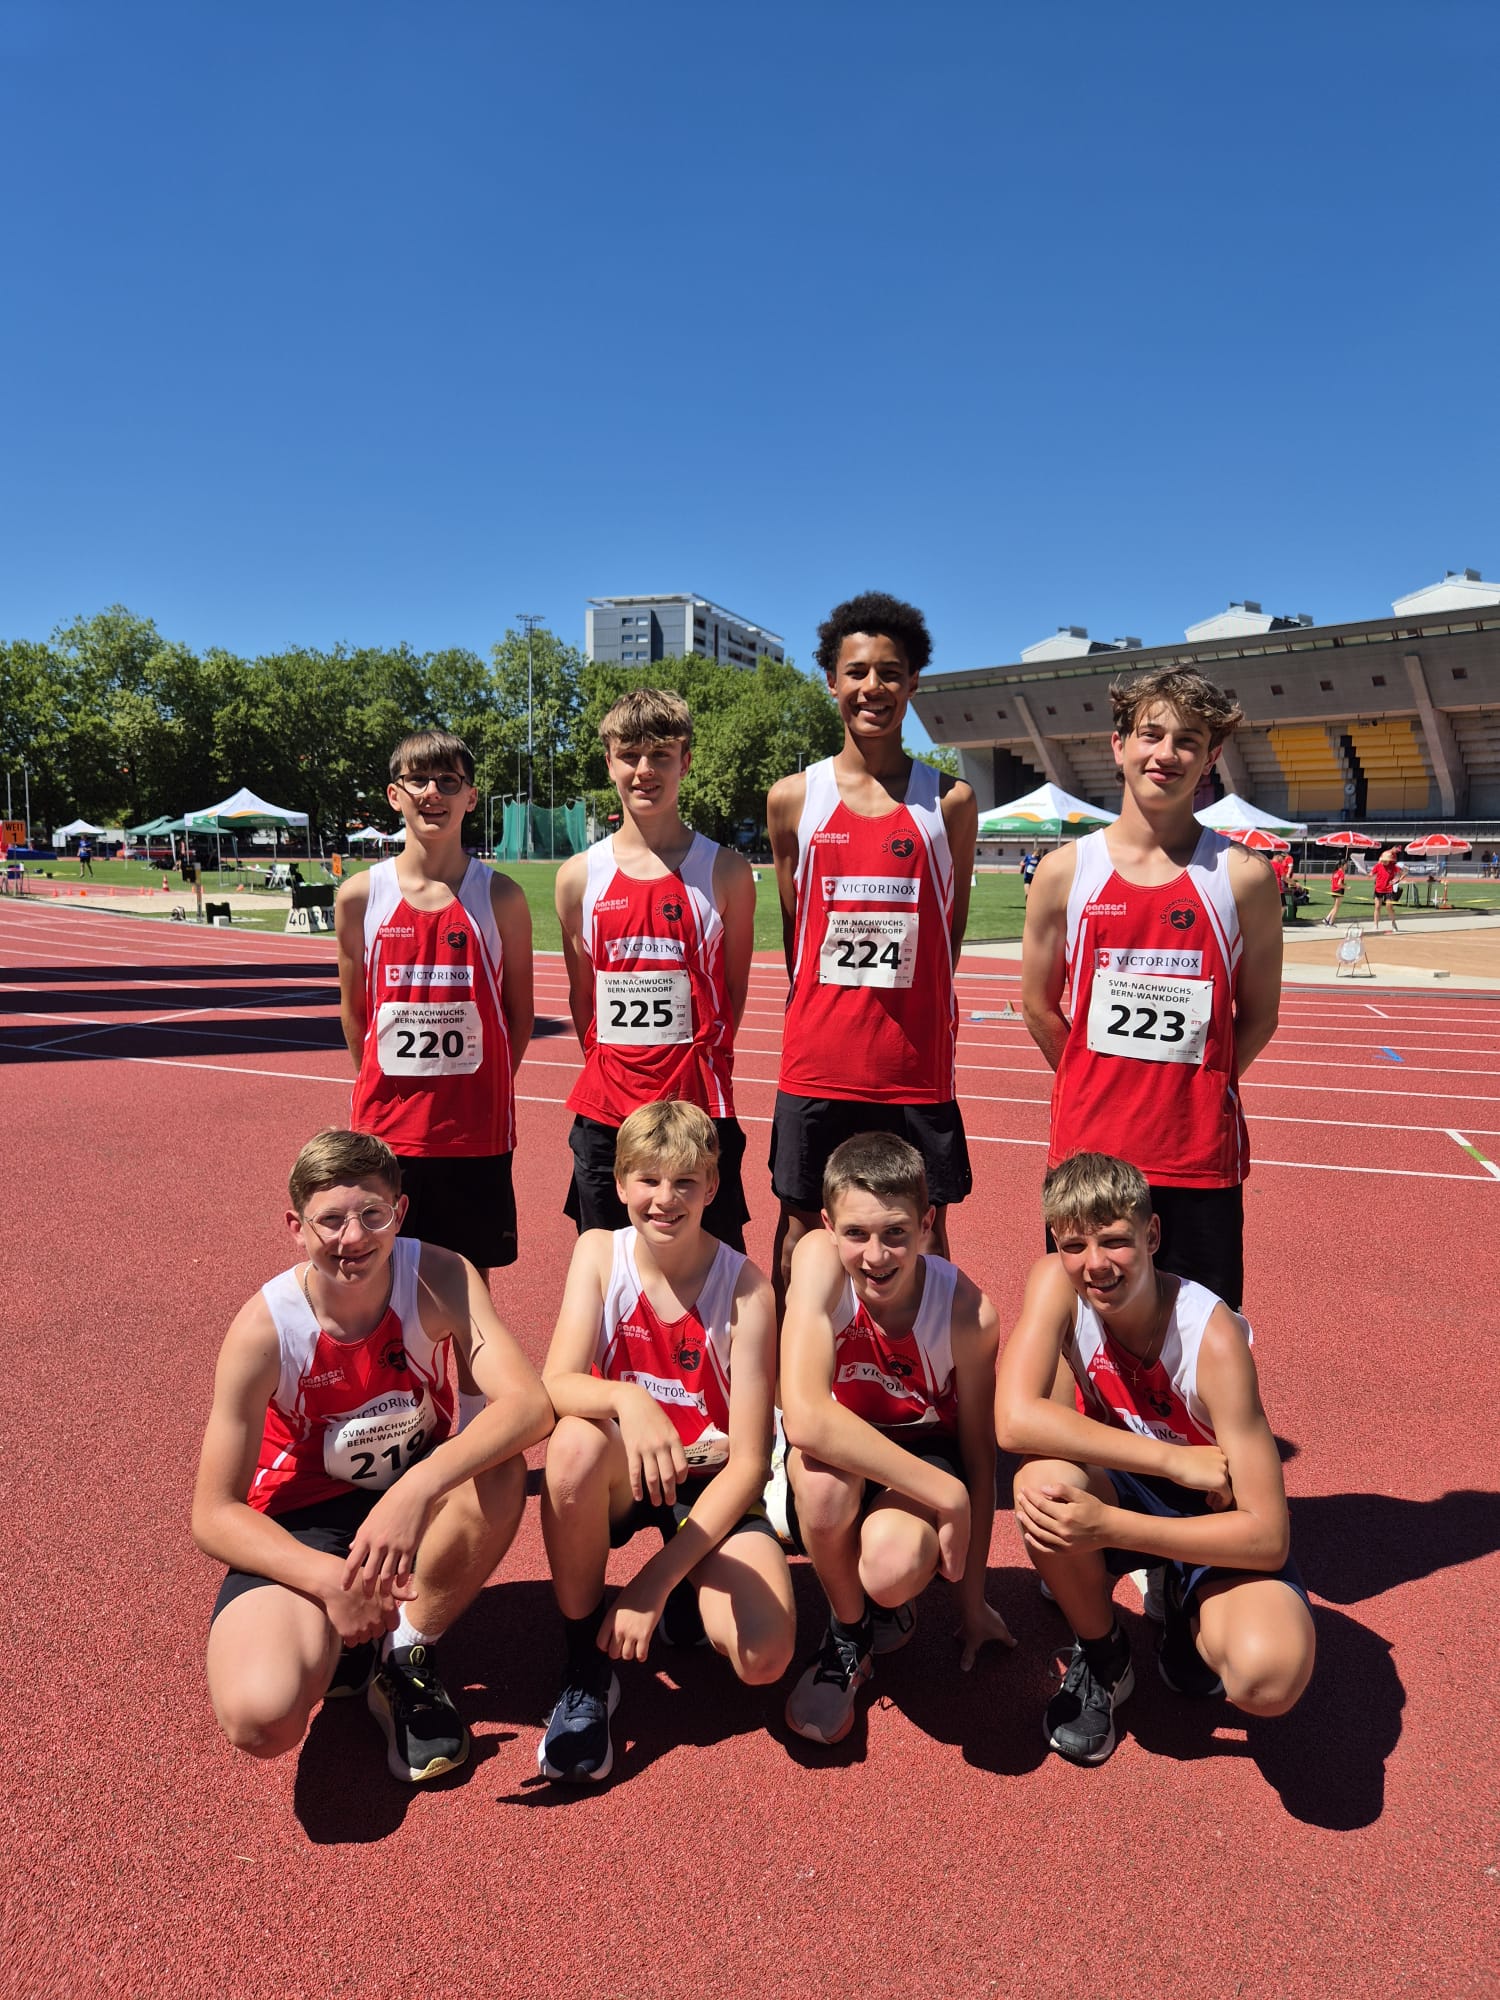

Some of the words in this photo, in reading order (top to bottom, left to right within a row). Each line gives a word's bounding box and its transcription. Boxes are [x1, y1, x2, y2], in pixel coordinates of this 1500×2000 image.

[5, 823, 23, 832] WEIT
[842, 884, 916, 896] VICTORINOX
[1085, 901, 1127, 913] panzeri
[289, 912, 306, 926] 40
[832, 919, 906, 927] SVM-NACHWUCHS,
[834, 927, 903, 935] BERN-WANKDORF
[623, 942, 683, 956] VICTORINOX
[837, 940, 902, 970] 224
[1116, 956, 1199, 968] VICTORINOX
[406, 971, 471, 980] VICTORINOX
[604, 977, 676, 986] SVM-NACHWUCHS,
[1109, 979, 1194, 996] SVM-NACHWUCHS,
[1111, 989, 1190, 1004] BERN-WANKDORF
[392, 1009, 467, 1017] SVM-NACHWUCHS,
[609, 999, 673, 1028] 225
[1107, 1004, 1186, 1043] 223
[396, 1030, 464, 1059] 220
[350, 1428, 425, 1480] 219
